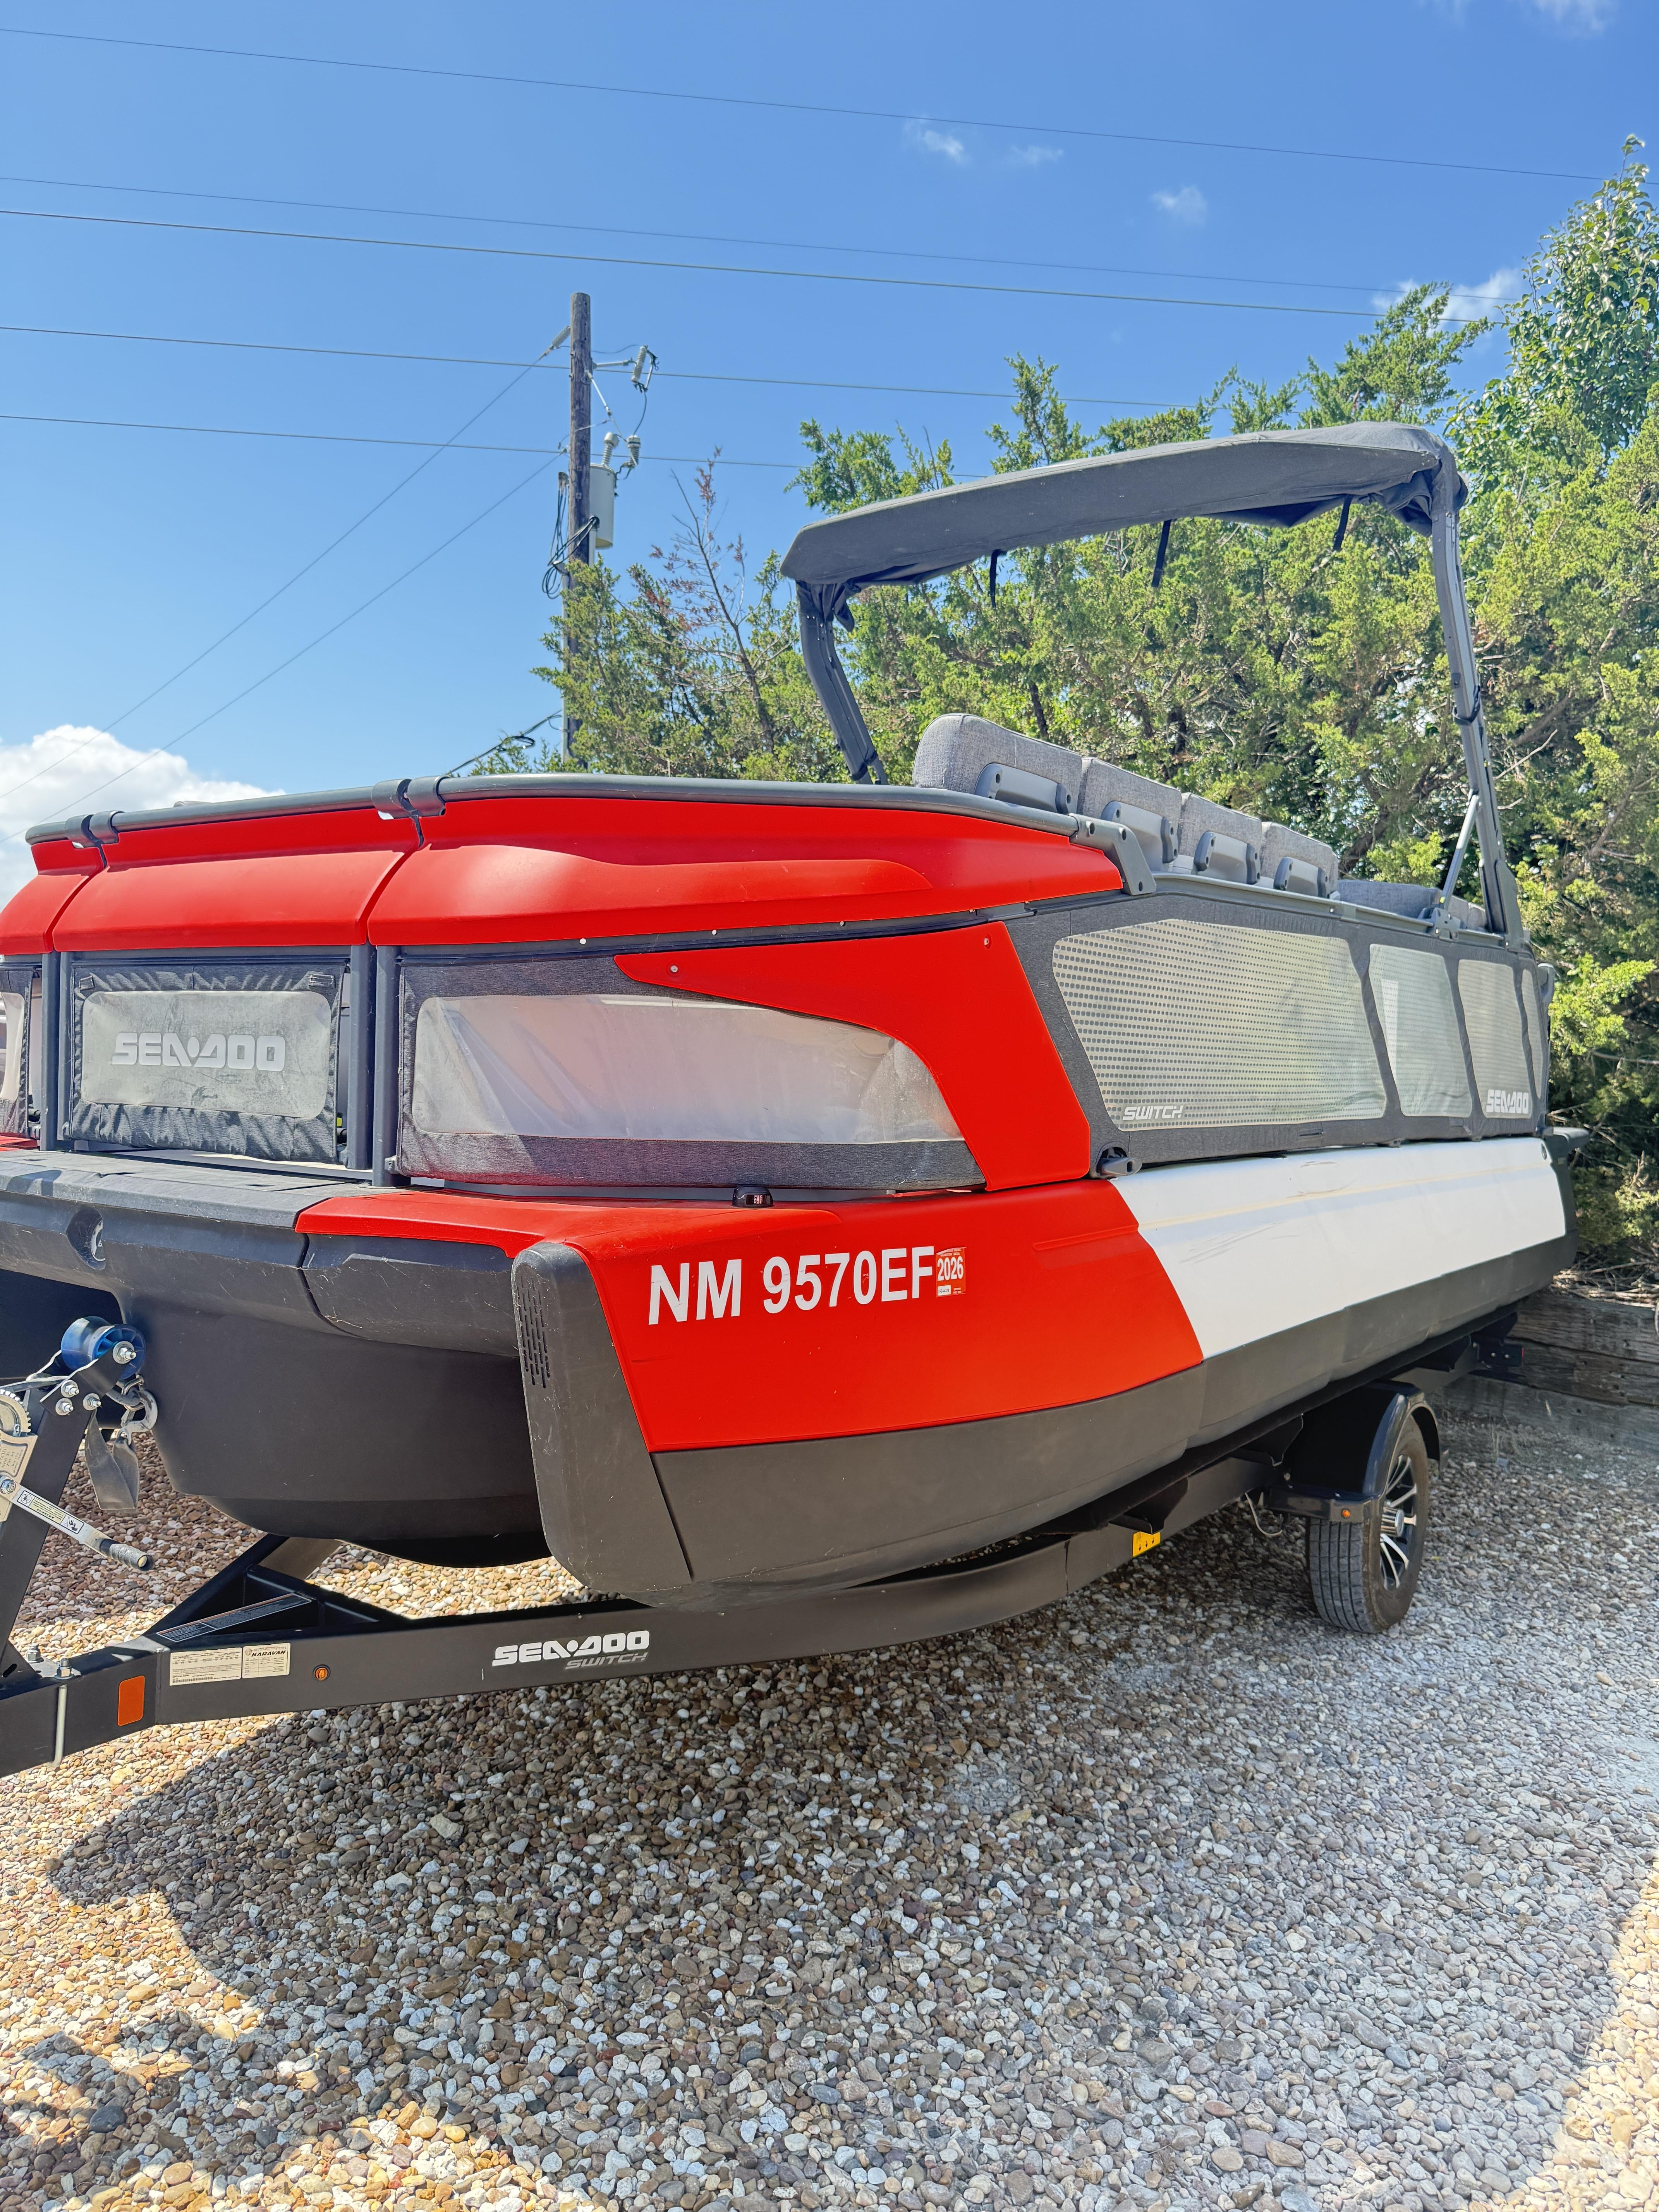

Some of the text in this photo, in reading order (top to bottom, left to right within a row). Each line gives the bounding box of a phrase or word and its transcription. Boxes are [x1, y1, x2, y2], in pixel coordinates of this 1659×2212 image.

[1122, 1105, 1183, 1120] SWITCH
[937, 1256, 964, 1281] 2026
[648, 1246, 935, 1325] NM 9570EF
[565, 1652, 649, 1669] SWITCH
